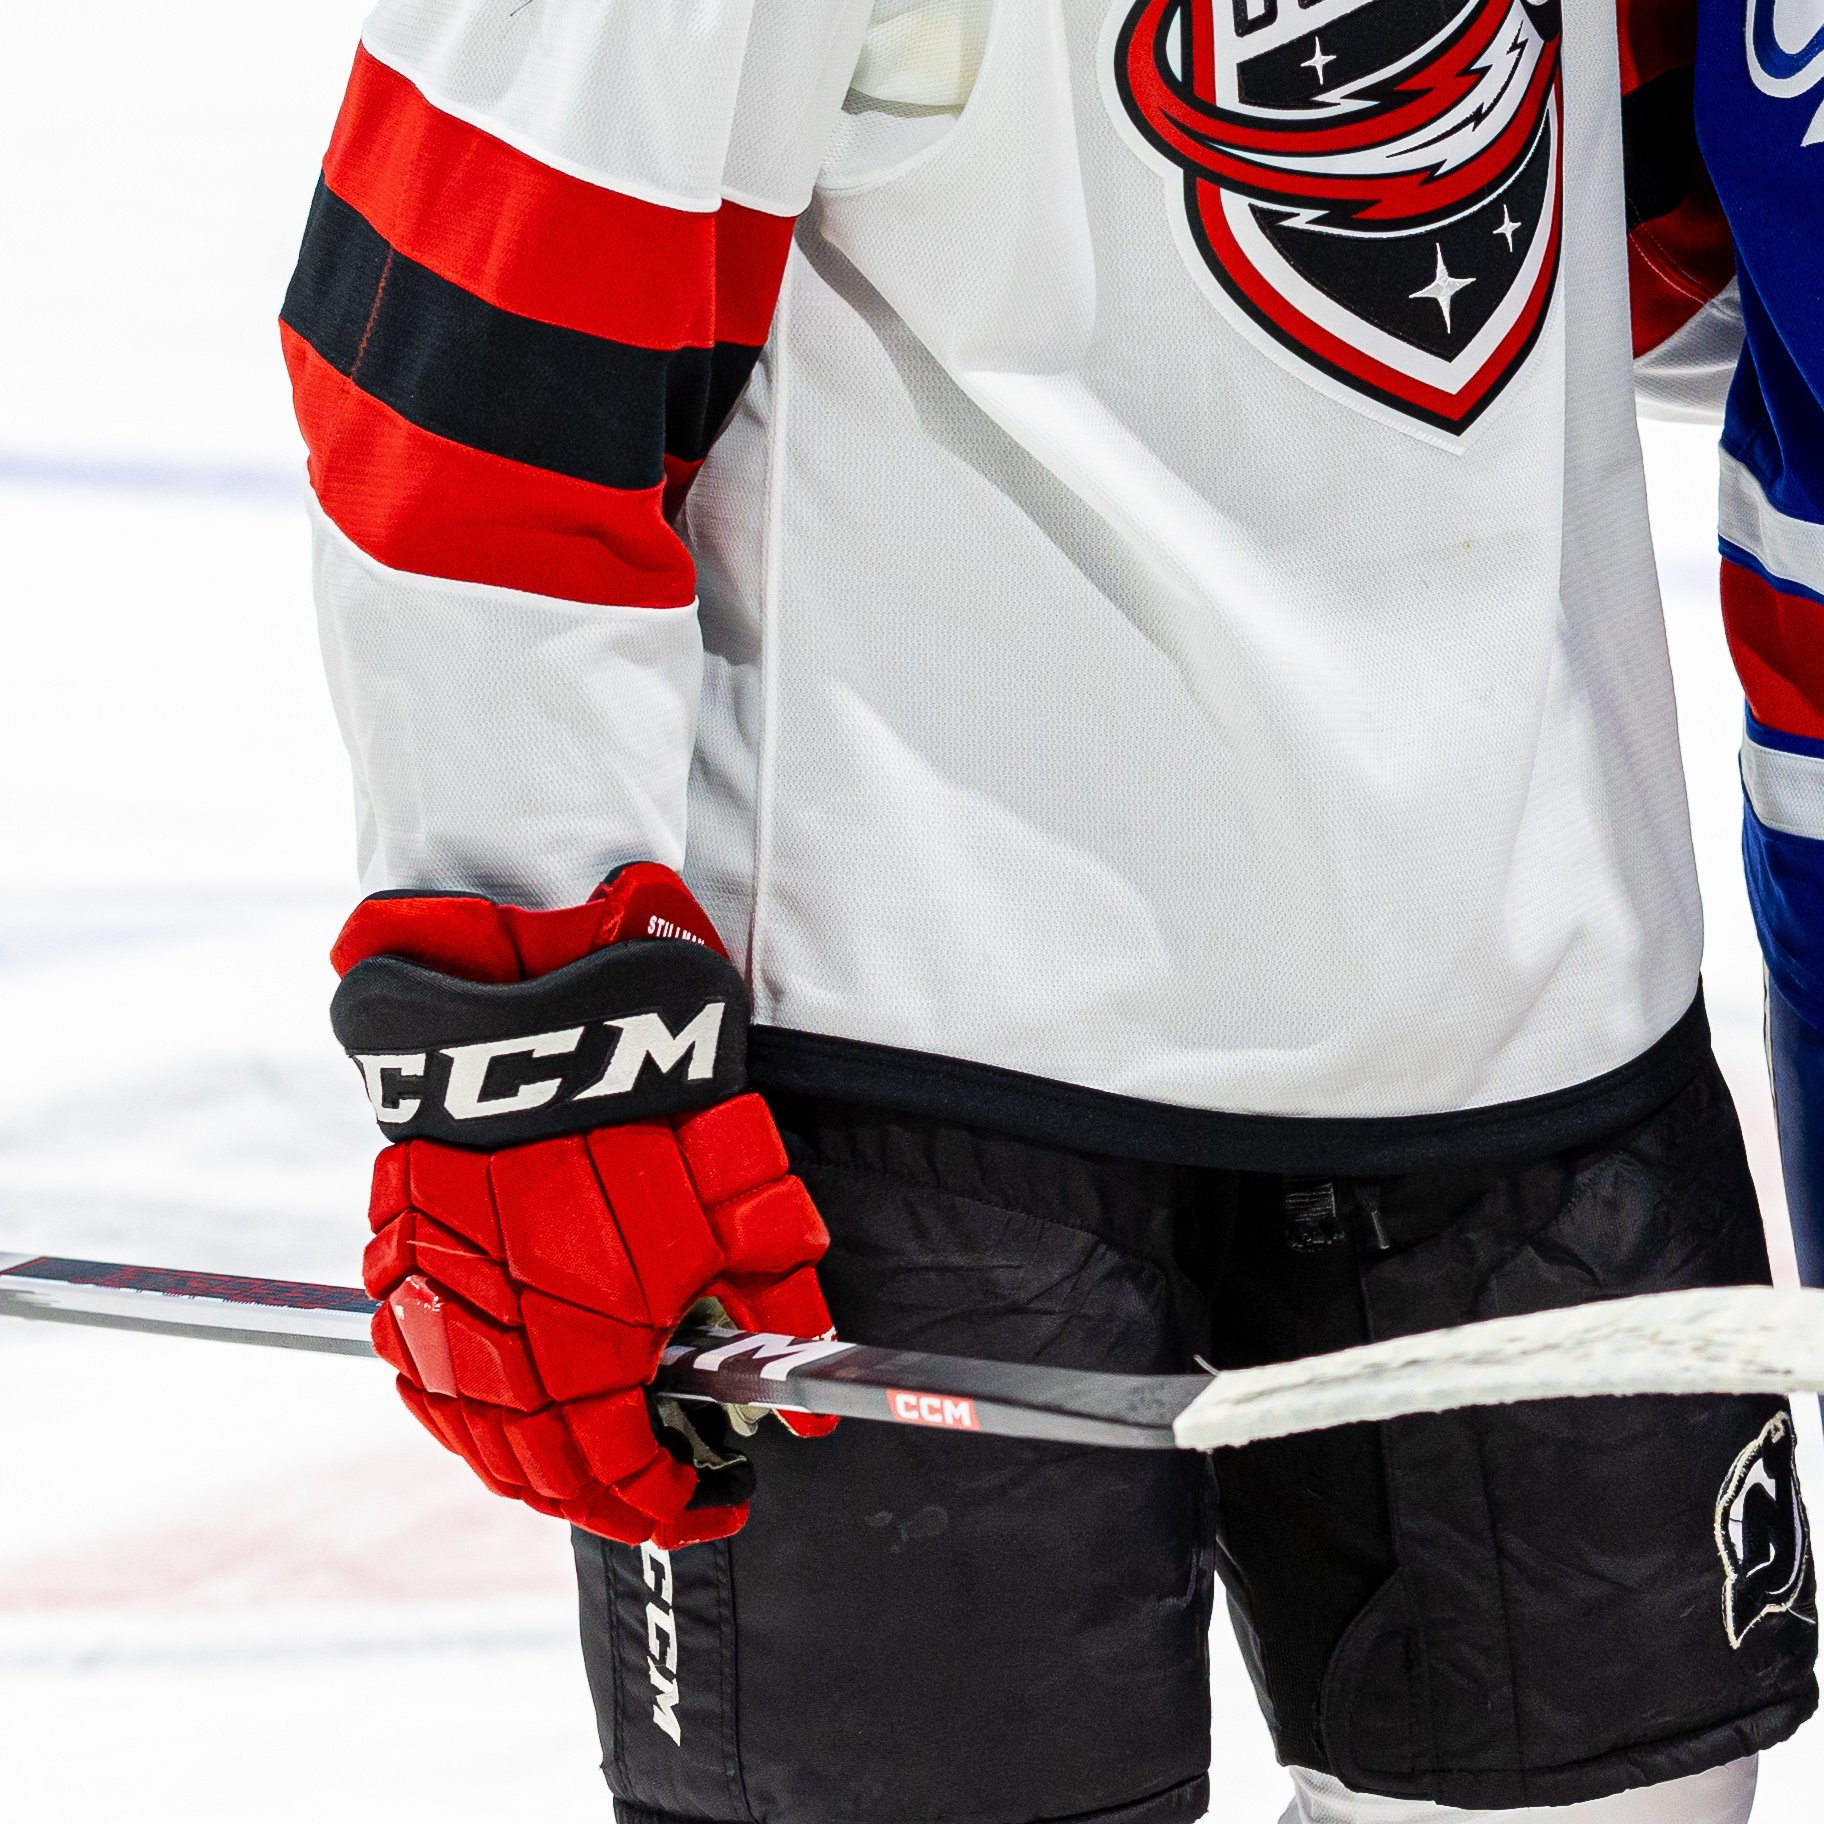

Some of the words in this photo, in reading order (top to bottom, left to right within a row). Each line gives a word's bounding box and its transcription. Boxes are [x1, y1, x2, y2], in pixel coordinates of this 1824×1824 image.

[354, 1001, 726, 1124] CCM
[894, 1392, 973, 1427] CCM
[640, 1538, 682, 1747] CCM
